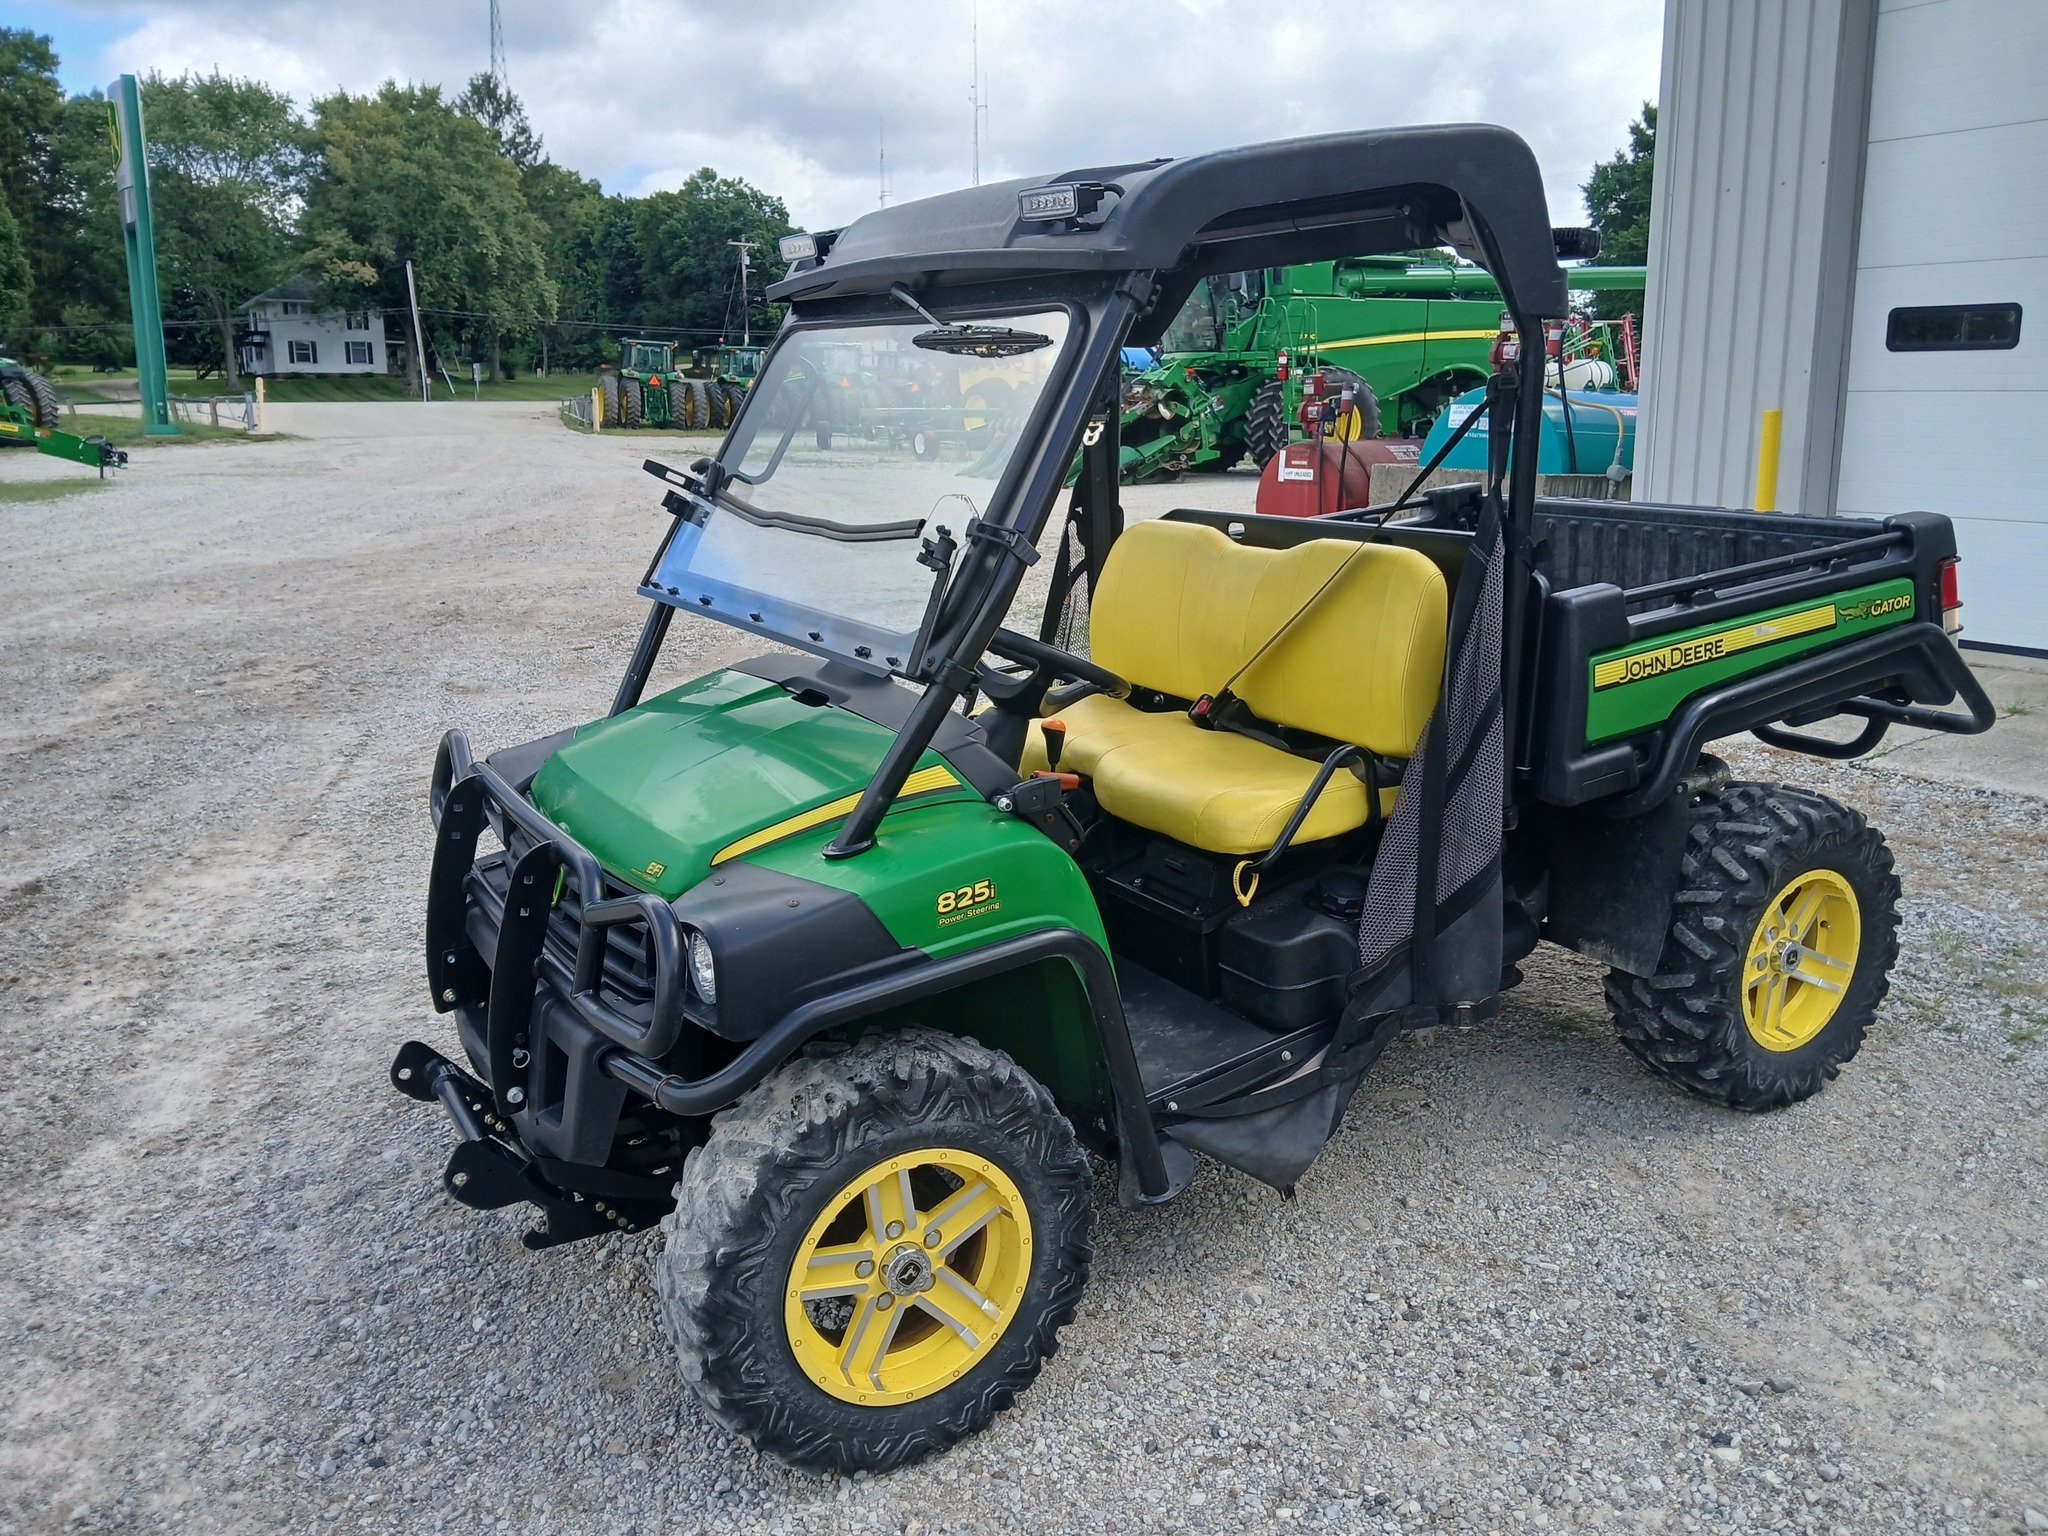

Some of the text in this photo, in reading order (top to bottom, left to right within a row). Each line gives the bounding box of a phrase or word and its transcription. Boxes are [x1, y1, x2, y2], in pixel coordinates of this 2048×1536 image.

[1870, 594, 1912, 617] GATOR
[1619, 638, 1725, 682] JOHN DEERE
[646, 861, 665, 878] EFI
[937, 879, 995, 914] 825i
[939, 902, 1000, 926] Power Steering
